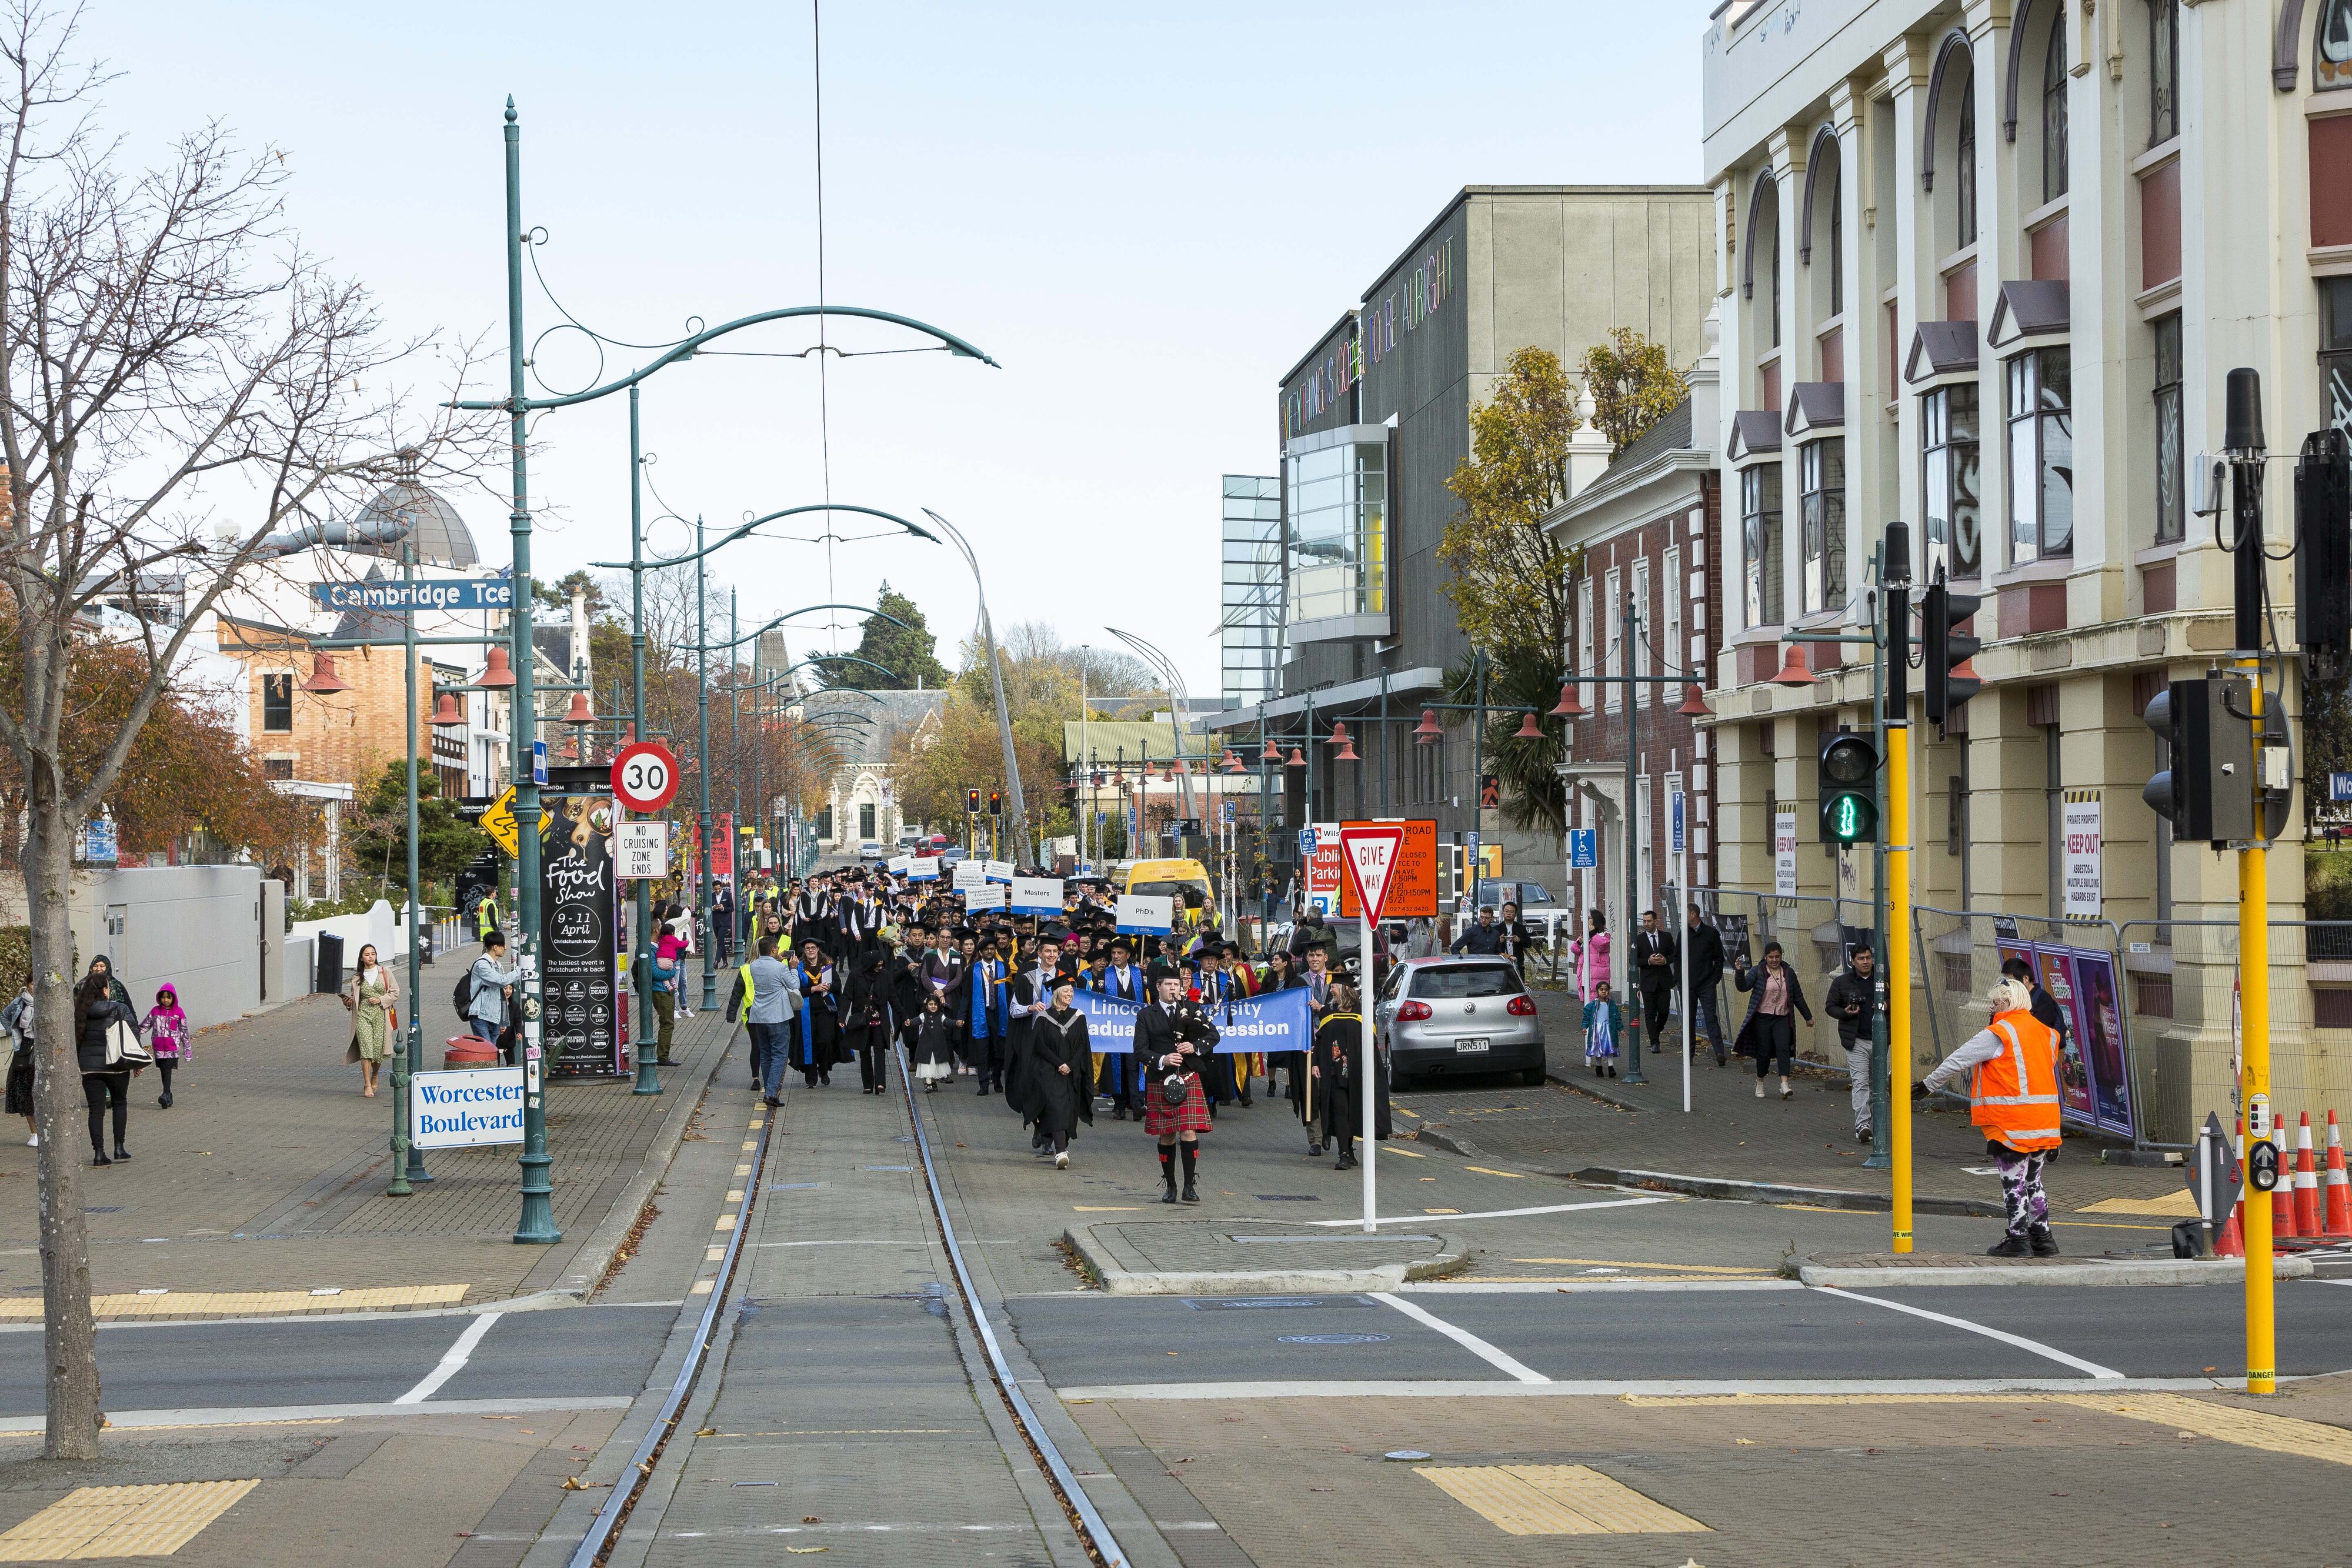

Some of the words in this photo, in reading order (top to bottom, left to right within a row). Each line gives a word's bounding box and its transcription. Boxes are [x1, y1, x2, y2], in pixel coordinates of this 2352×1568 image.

[1280, 366, 1325, 447] EVERYTHING
[1327, 357, 1334, 405] IS
[1337, 326, 1365, 396] GOING
[1368, 311, 1381, 366] TO
[1385, 292, 1398, 352] BE
[1402, 235, 1453, 338] ALRIGHT
[331, 584, 460, 609] Cambridge
[472, 583, 511, 603] Tce
[628, 765, 664, 790] 30
[2067, 814, 2081, 825] PRIVATE
[2081, 814, 2099, 824] PROPERTY
[636, 826, 646, 836] NO
[1406, 826, 1432, 835] ROAD
[1579, 830, 1587, 840] P
[623, 838, 659, 849] CRUISING
[1777, 837, 1787, 852] KEEP
[1787, 836, 1795, 852] OUT
[2067, 834, 2084, 854] KEEP
[2084, 833, 2099, 854] OUT
[556, 855, 588, 867] The
[632, 851, 651, 862] ZONE
[1360, 846, 1384, 866] GIVE
[632, 864, 652, 875] ENDS
[2073, 864, 2090, 874] ASBESTOS
[2090, 864, 2093, 873] &
[546, 860, 605, 890] Food
[1365, 875, 1380, 890] WAY
[2067, 878, 2083, 887] MULTIPLE
[2083, 878, 2099, 887] BUILDING
[556, 885, 595, 904] Show
[2071, 892, 2086, 901] HAZARDS
[2086, 892, 2096, 902] EXIST
[2240, 890, 2246, 903] 4
[1890, 901, 1895, 911] 3
[558, 913, 565, 923] 9
[576, 913, 590, 923] 11
[1994, 918, 2016, 930] PHANTOM
[561, 925, 590, 936] April
[1457, 1042, 1487, 1051] JRN511
[420, 1083, 524, 1105] Worcester
[420, 1107, 524, 1134] Boulevard
